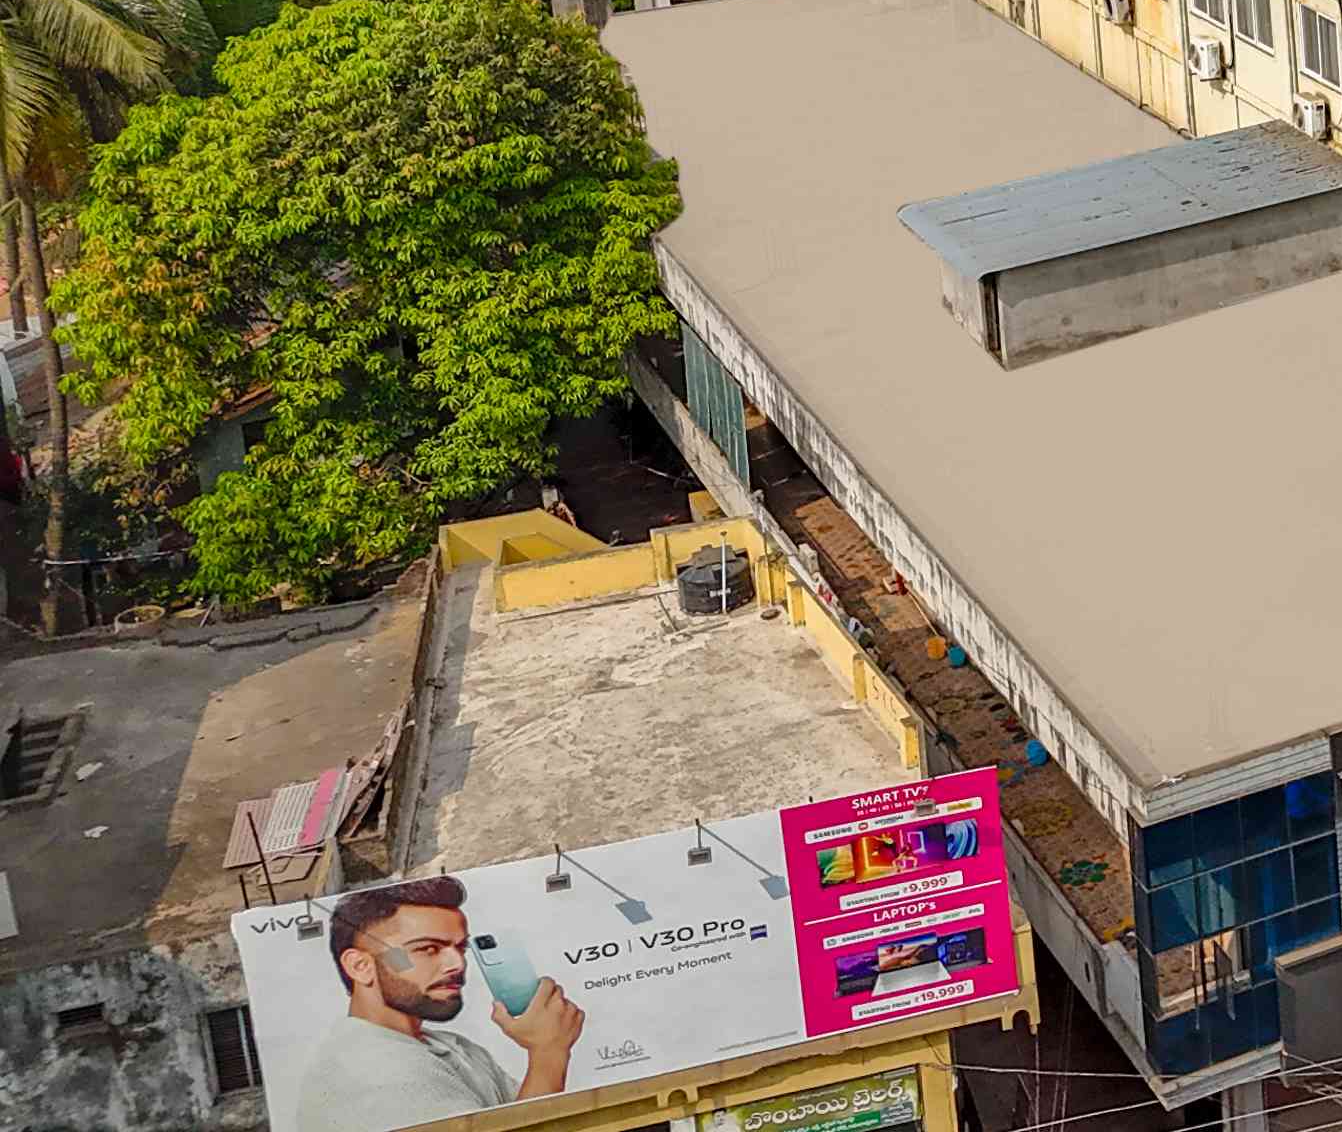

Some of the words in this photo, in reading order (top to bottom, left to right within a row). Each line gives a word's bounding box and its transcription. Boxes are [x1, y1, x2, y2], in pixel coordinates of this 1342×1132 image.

[852, 789, 899, 810] SMART
[873, 900, 936, 922] LAPTOP's
[250, 912, 313, 937] vivo
[564, 942, 620, 965] V30
[640, 926, 694, 949] V30
[702, 918, 745, 937] Pro
[584, 972, 633, 990] Delight
[635, 964, 675, 981] Every
[677, 951, 733, 971] Moment
